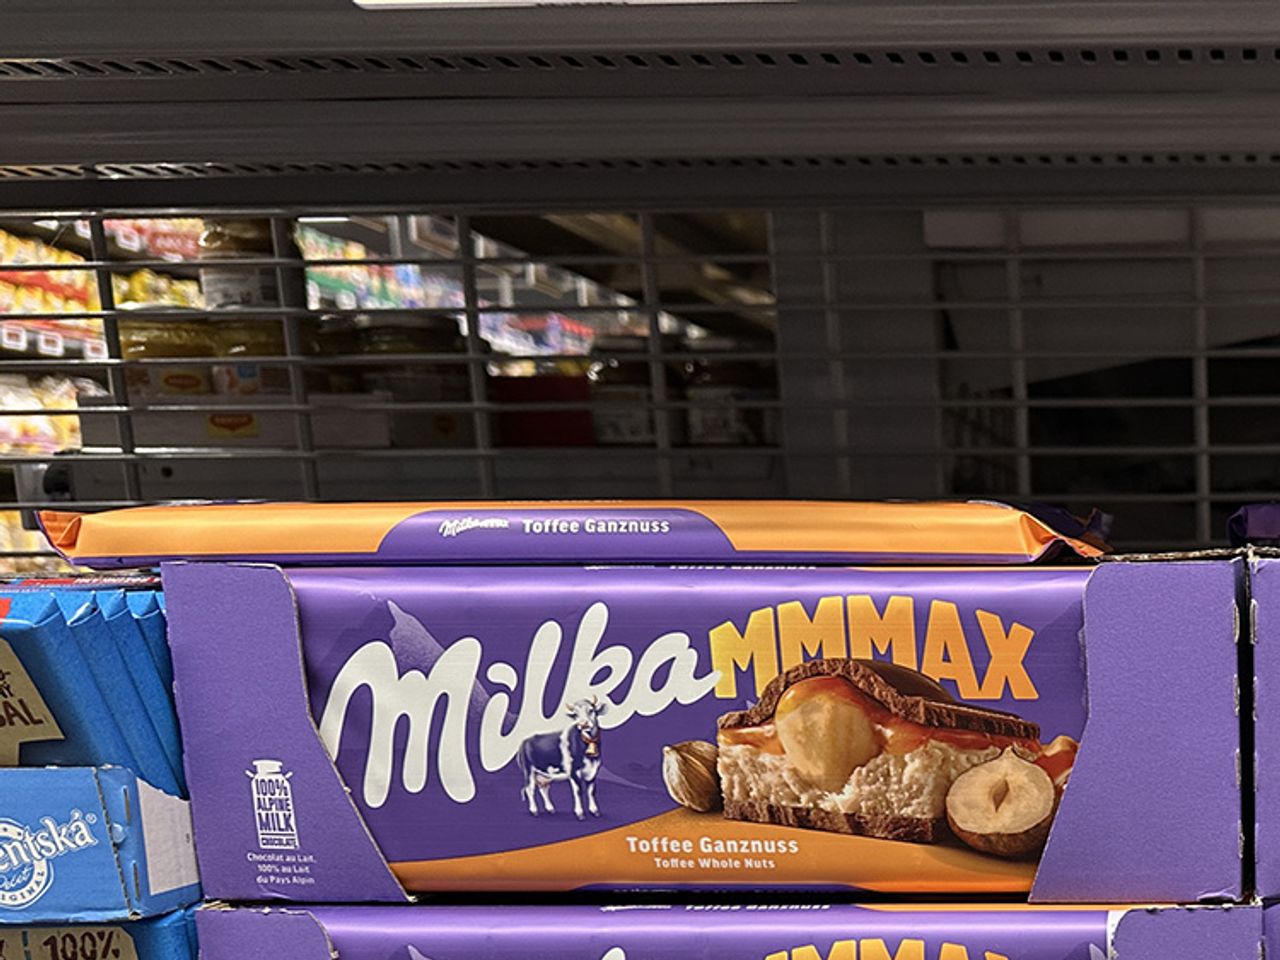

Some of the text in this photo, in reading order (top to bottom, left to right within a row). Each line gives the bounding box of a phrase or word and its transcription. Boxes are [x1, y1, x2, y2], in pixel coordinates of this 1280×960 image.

[522, 518, 580, 534] Toffee
[583, 518, 671, 534] Ganznuss
[319, 594, 1036, 809] Milka MMMAX
[254, 778, 289, 797] 100%
[256, 796, 292, 812] ALPINE
[257, 812, 295, 832] MILK
[626, 836, 800, 853] Toffee Ganznuss
[654, 857, 776, 869] Toffee Whole Nuts
